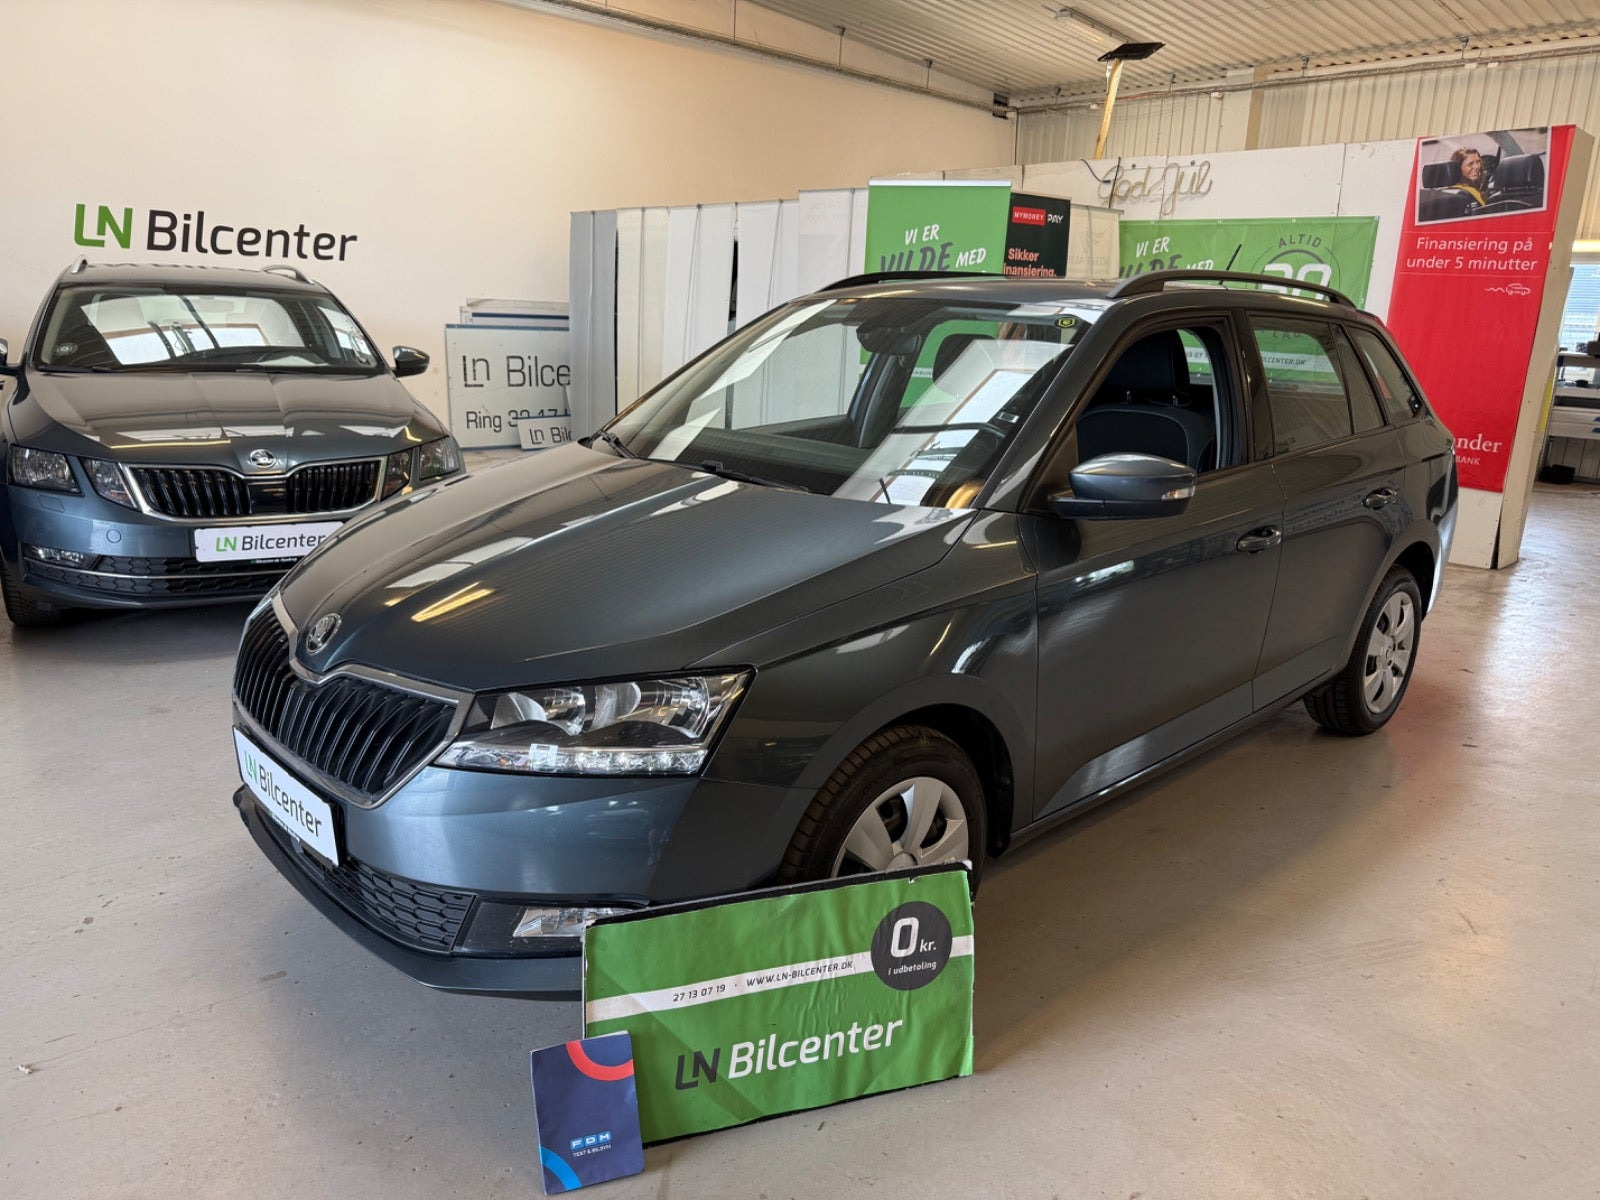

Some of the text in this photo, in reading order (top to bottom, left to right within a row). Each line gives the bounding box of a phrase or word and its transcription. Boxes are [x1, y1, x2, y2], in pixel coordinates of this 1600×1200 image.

[1047, 214, 1063, 223] PAY
[74, 203, 358, 261] LN Bilcenter
[905, 224, 940, 246] VI ER
[1008, 248, 1040, 262] Sikker
[1136, 236, 1170, 258] VI ER
[1416, 237, 1533, 254] Finansiering på
[955, 247, 987, 268] MED
[1406, 255, 1538, 271] under 5 minutter
[466, 411, 502, 433] Ring
[1455, 455, 1480, 465] BANK
[215, 533, 326, 552] LN Bilcenter
[244, 750, 322, 838] LN Bilcenter
[890, 917, 937, 958] 0 kr.
[893, 961, 937, 975] udbetaling
[672, 961, 853, 1002] 27 13 07 19 WWW.LN-BILCENTER.DK
[675, 1019, 903, 1091] LN Bilcenter
[571, 1132, 611, 1149] FDM
